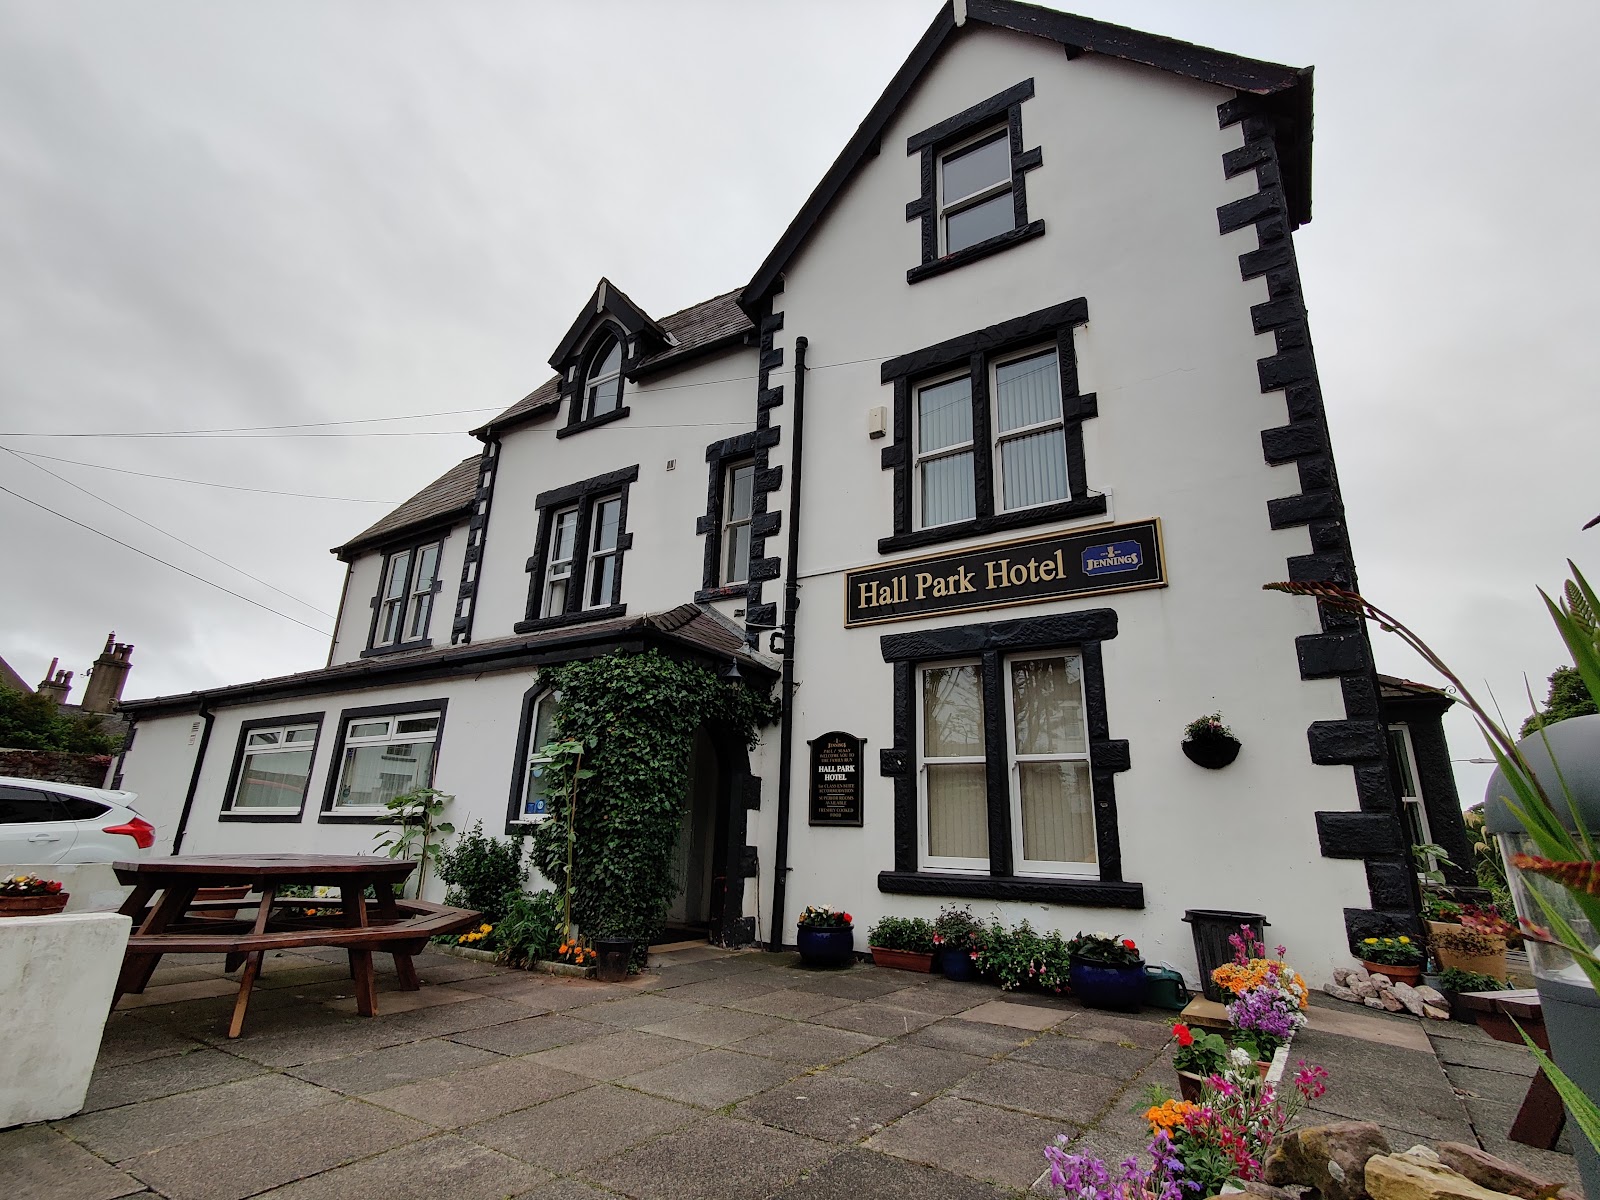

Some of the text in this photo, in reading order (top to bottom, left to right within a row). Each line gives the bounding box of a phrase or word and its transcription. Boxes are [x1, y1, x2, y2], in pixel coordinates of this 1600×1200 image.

[1086, 553, 1139, 571] JENNINGS
[857, 548, 1067, 609] Hall Park Hotel
[818, 764, 856, 773] HALL PARK
[824, 773, 847, 781] HOTEL
